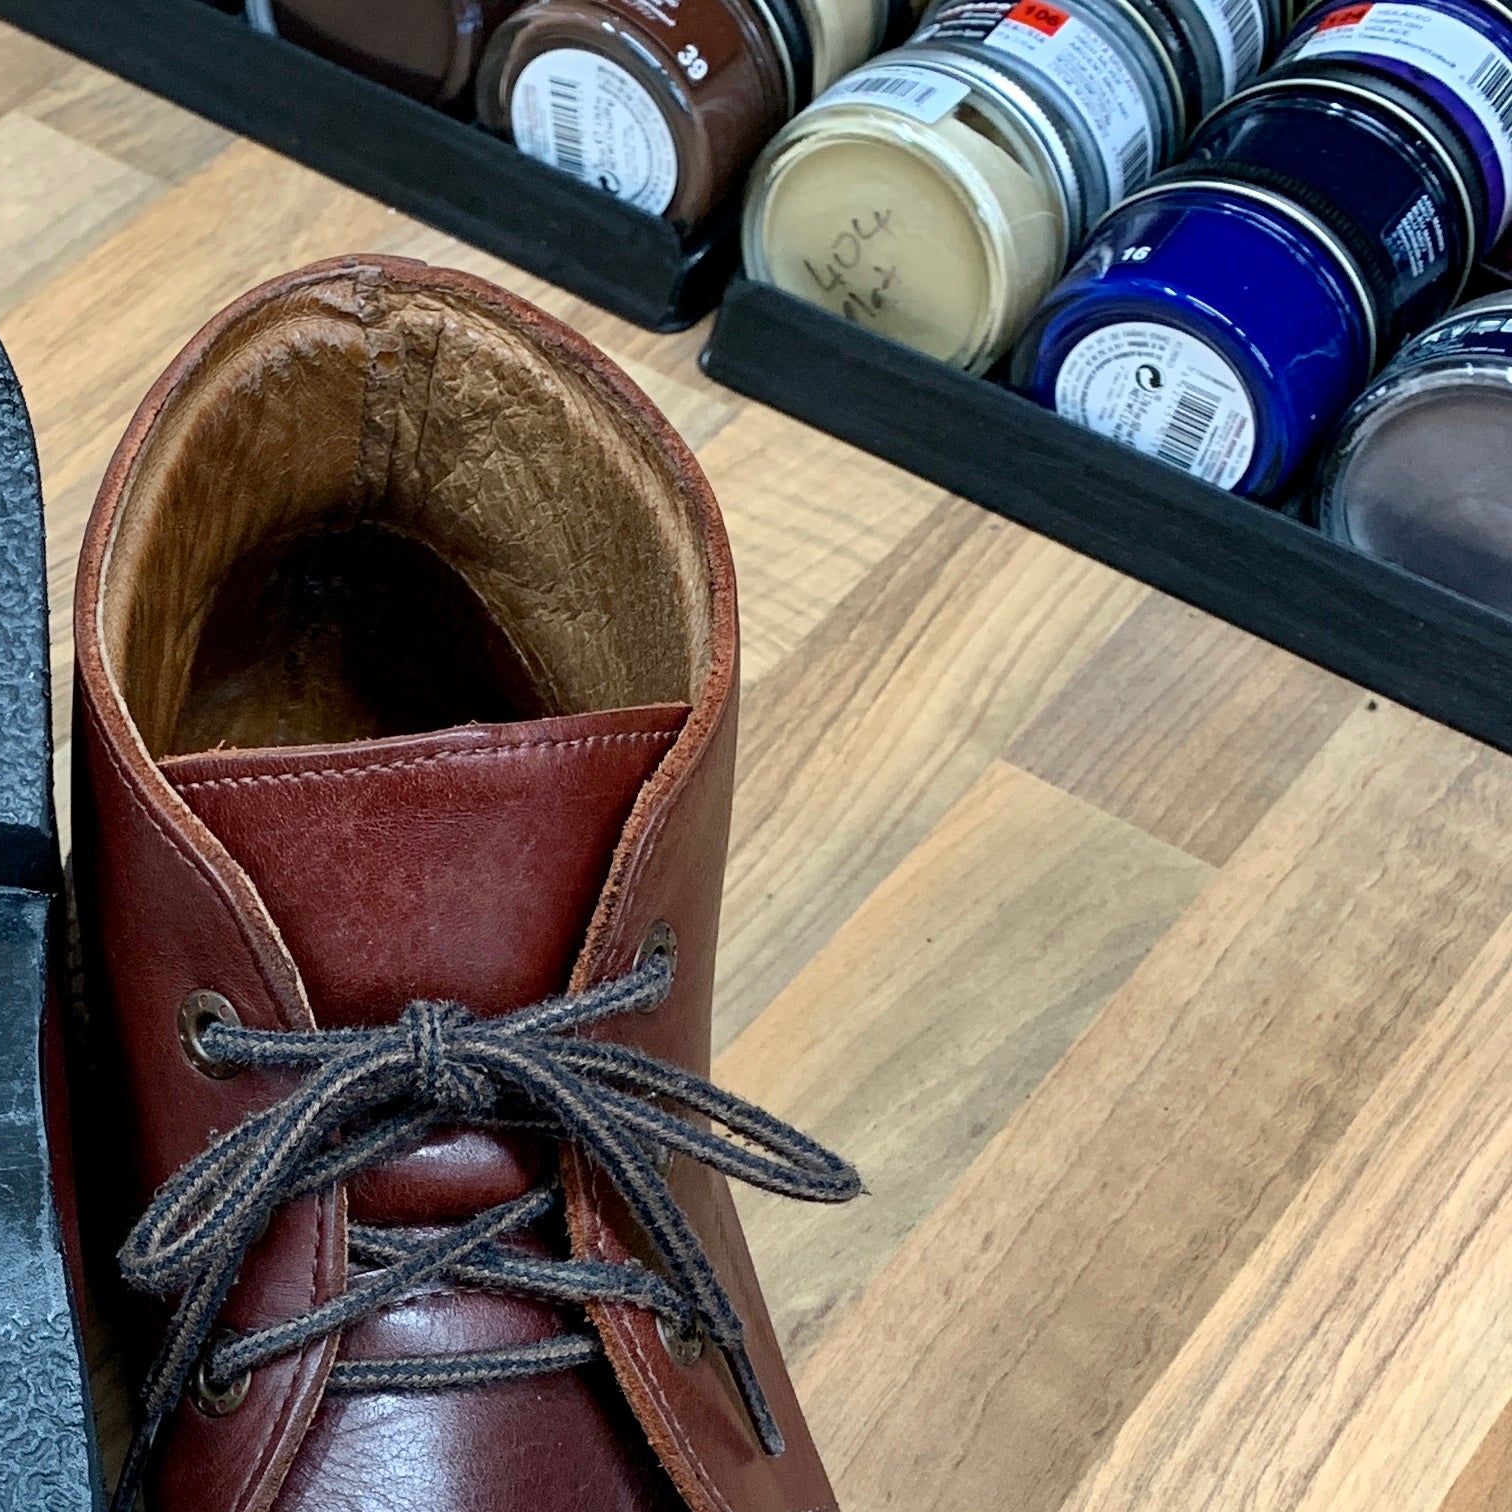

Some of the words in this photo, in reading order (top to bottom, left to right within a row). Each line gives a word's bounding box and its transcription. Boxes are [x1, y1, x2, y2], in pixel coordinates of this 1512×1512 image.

[1023, 5, 1061, 27] 106
[676, 43, 709, 81] 39
[1121, 246, 1152, 261] 16
